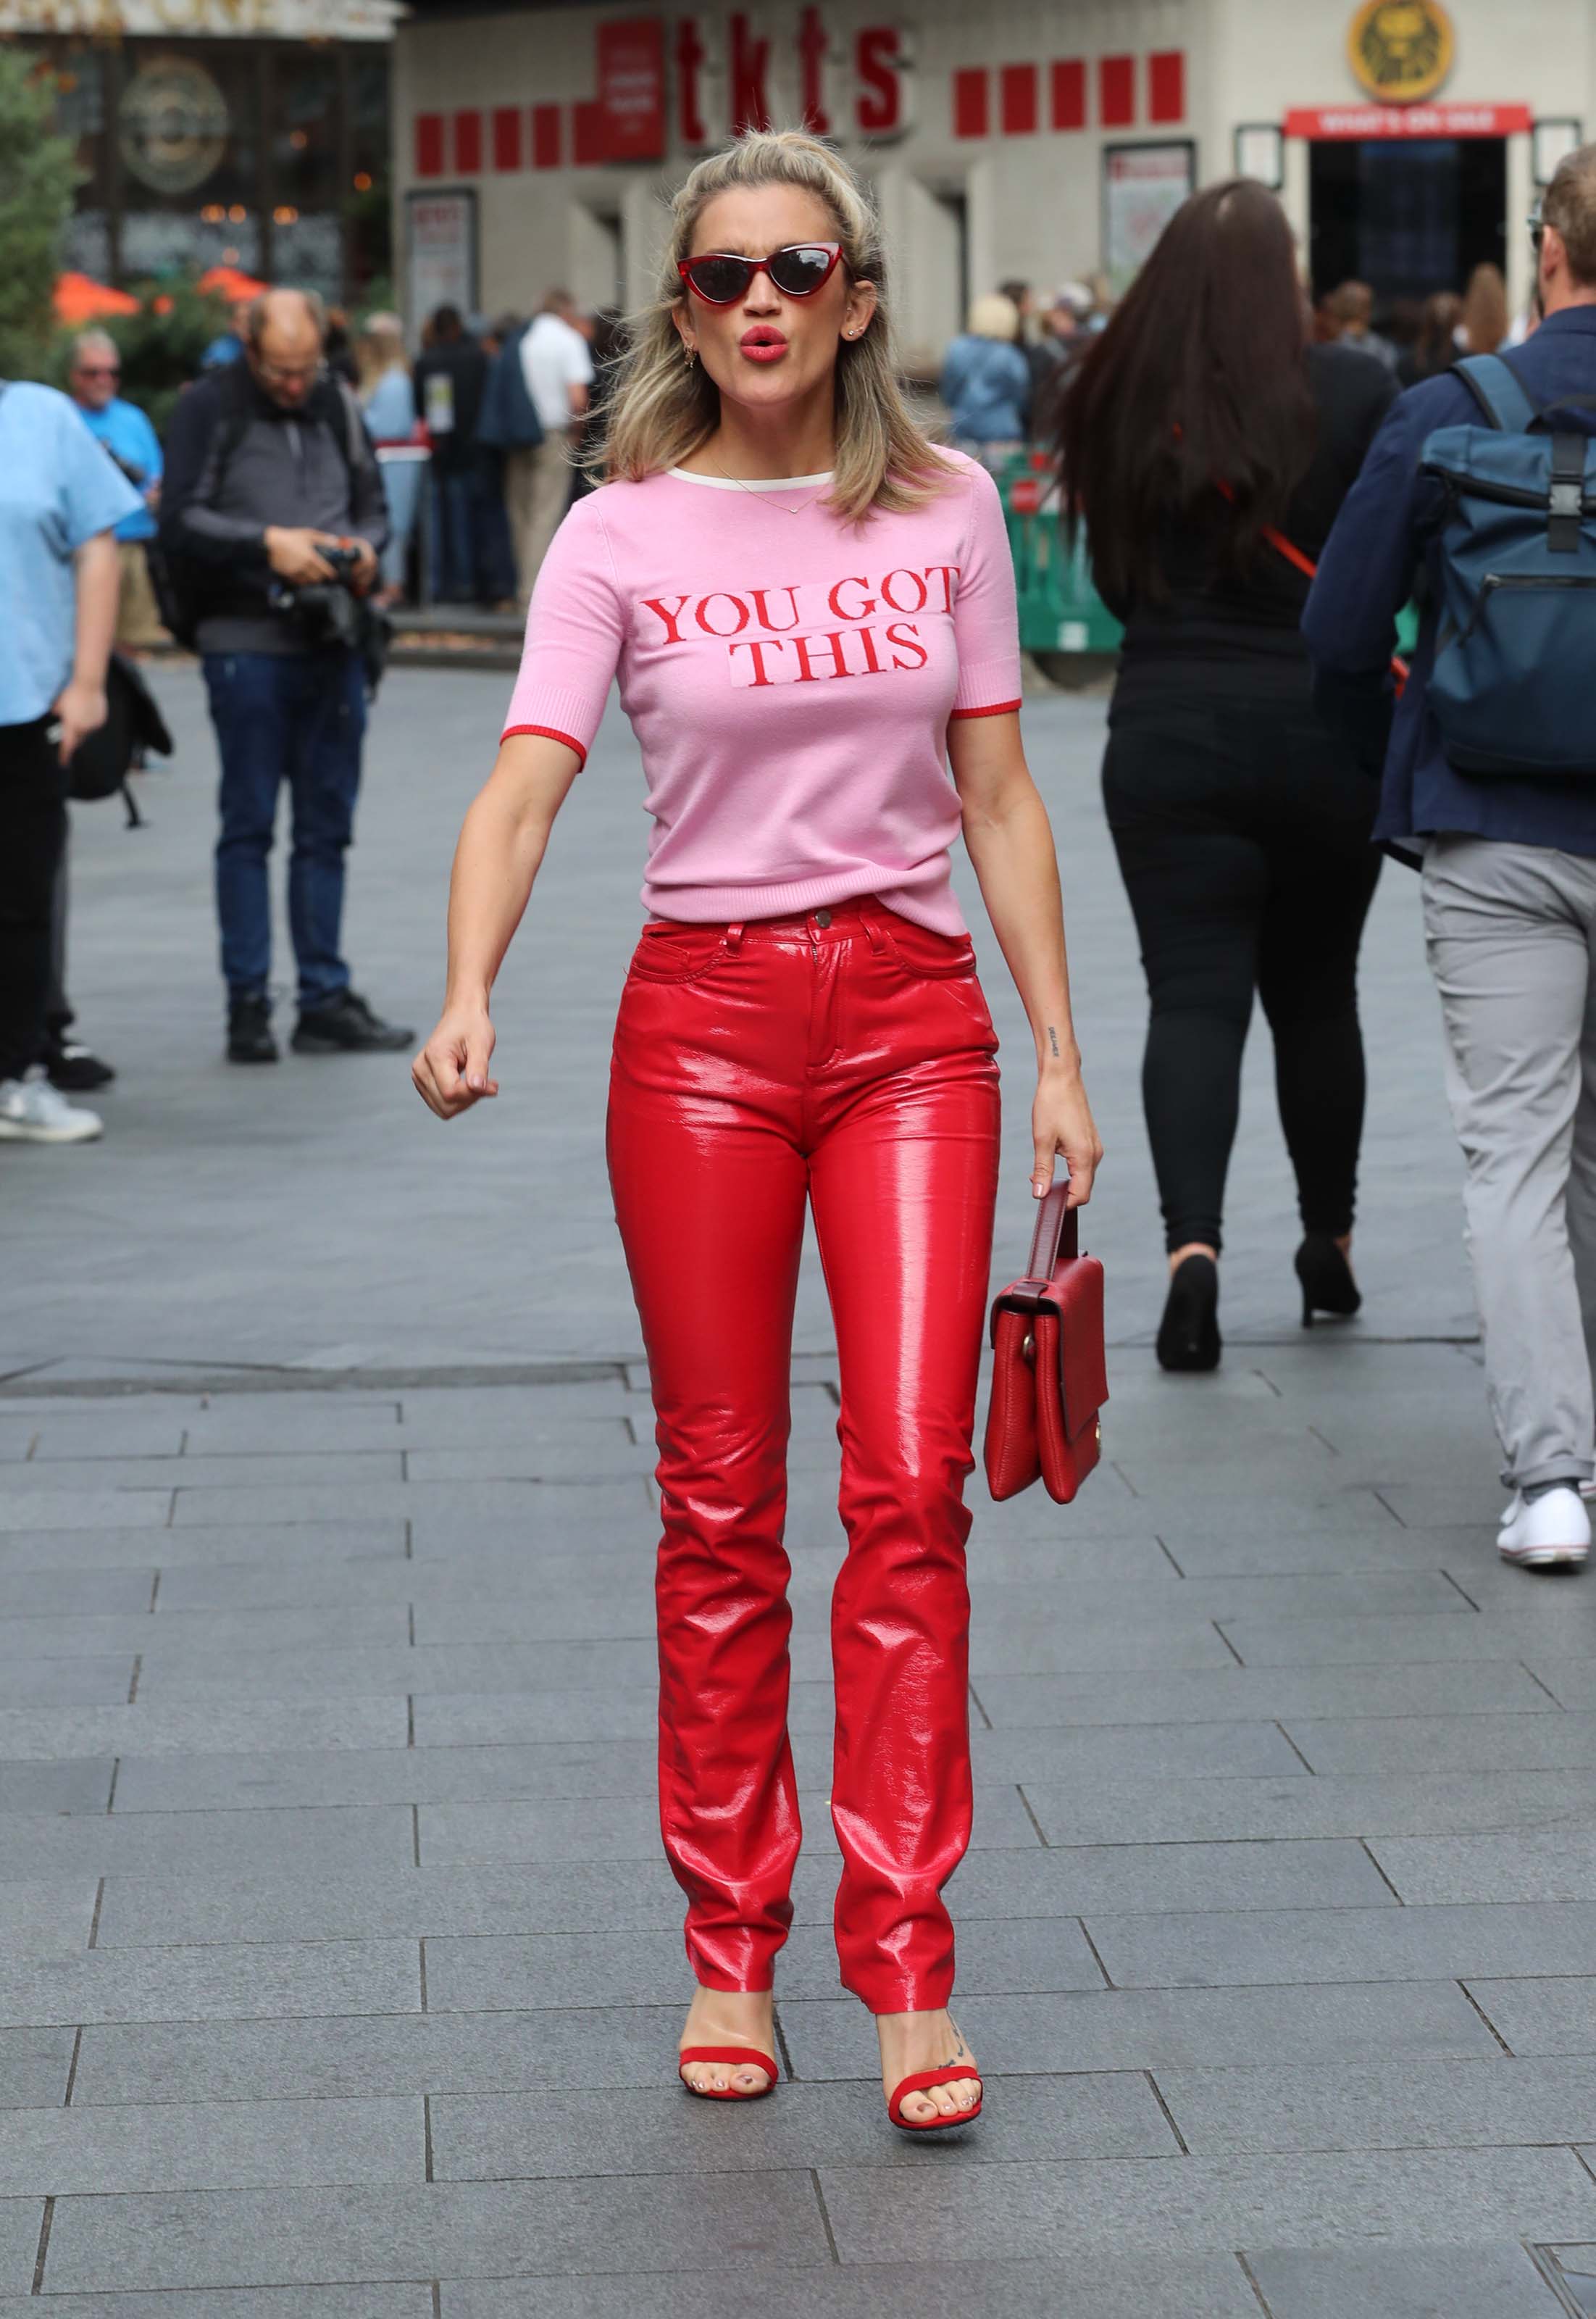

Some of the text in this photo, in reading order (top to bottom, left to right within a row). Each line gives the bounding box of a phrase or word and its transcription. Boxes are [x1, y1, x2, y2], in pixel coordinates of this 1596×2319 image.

[677, 7, 900, 141] tkts
[640, 567, 961, 645] YOU GOT
[729, 623, 928, 687] THIS
